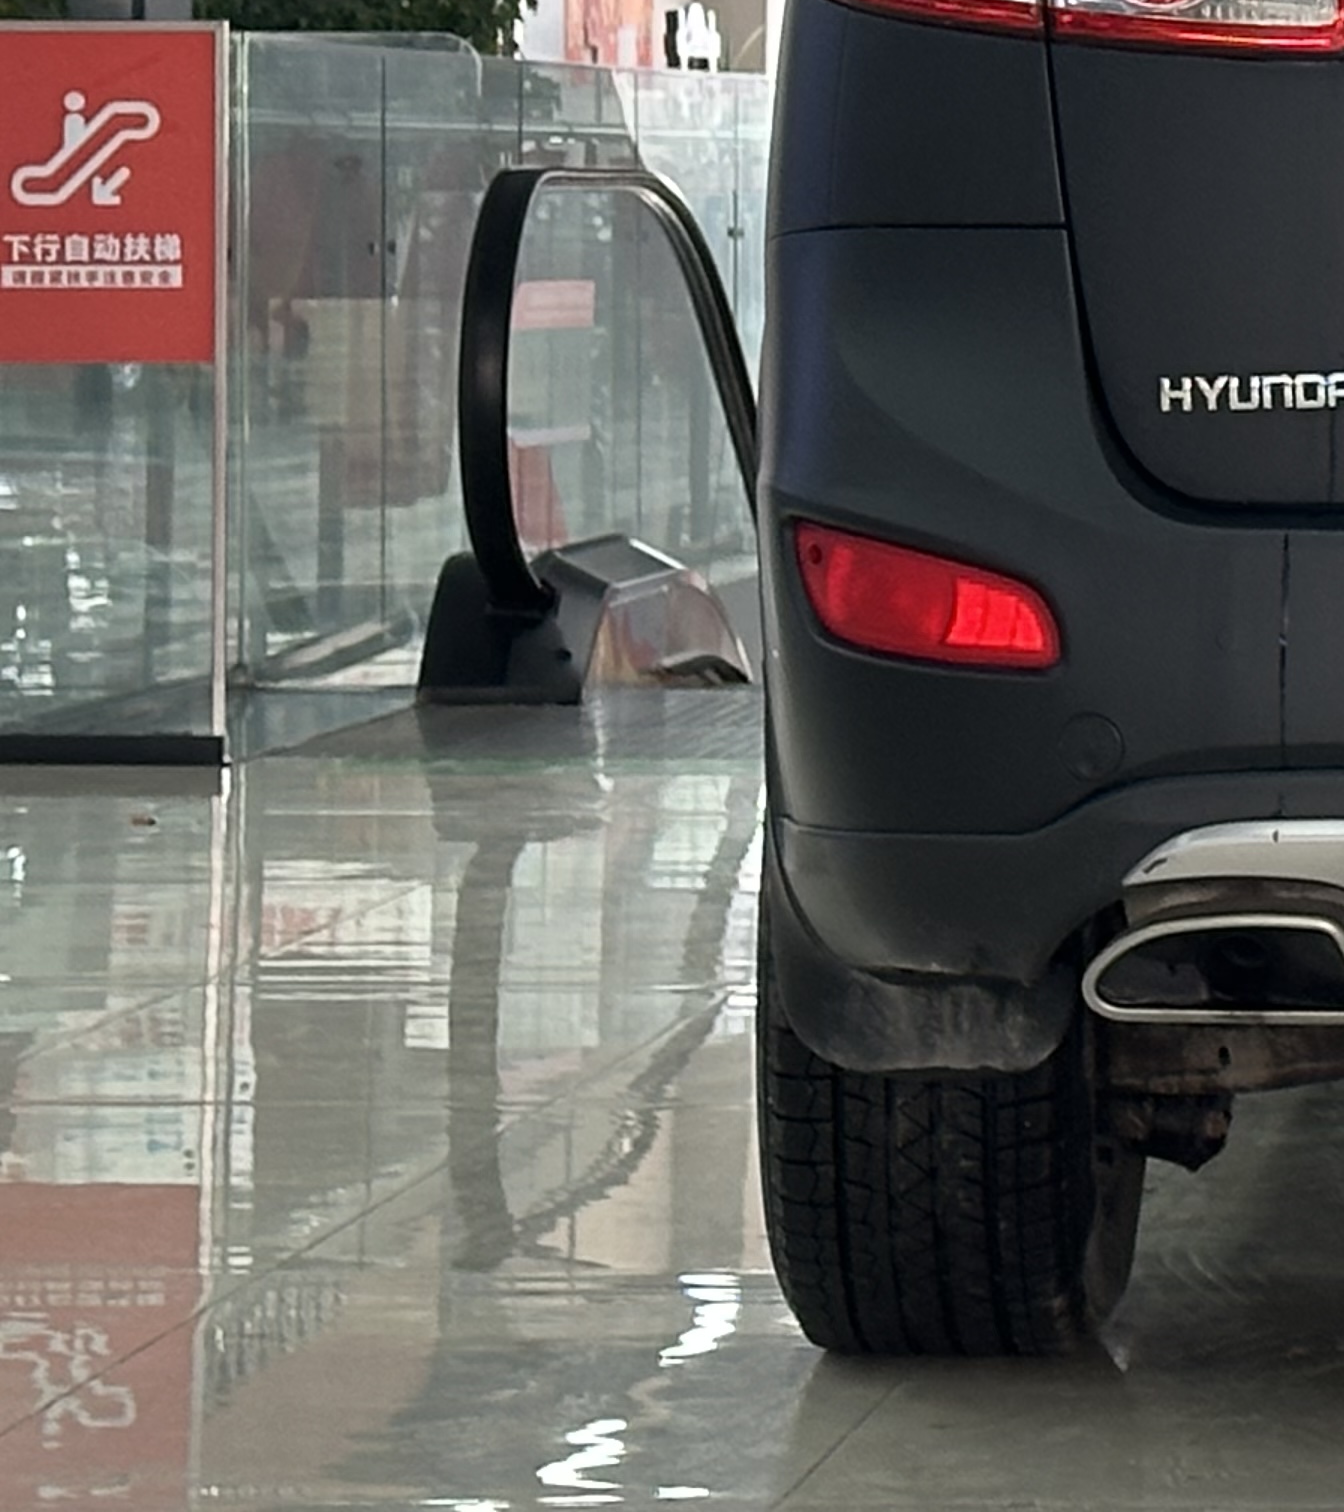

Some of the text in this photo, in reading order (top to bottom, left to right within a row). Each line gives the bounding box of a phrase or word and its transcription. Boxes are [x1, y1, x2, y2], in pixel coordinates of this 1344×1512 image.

[2, 232, 182, 263] 下行自动扶梯
